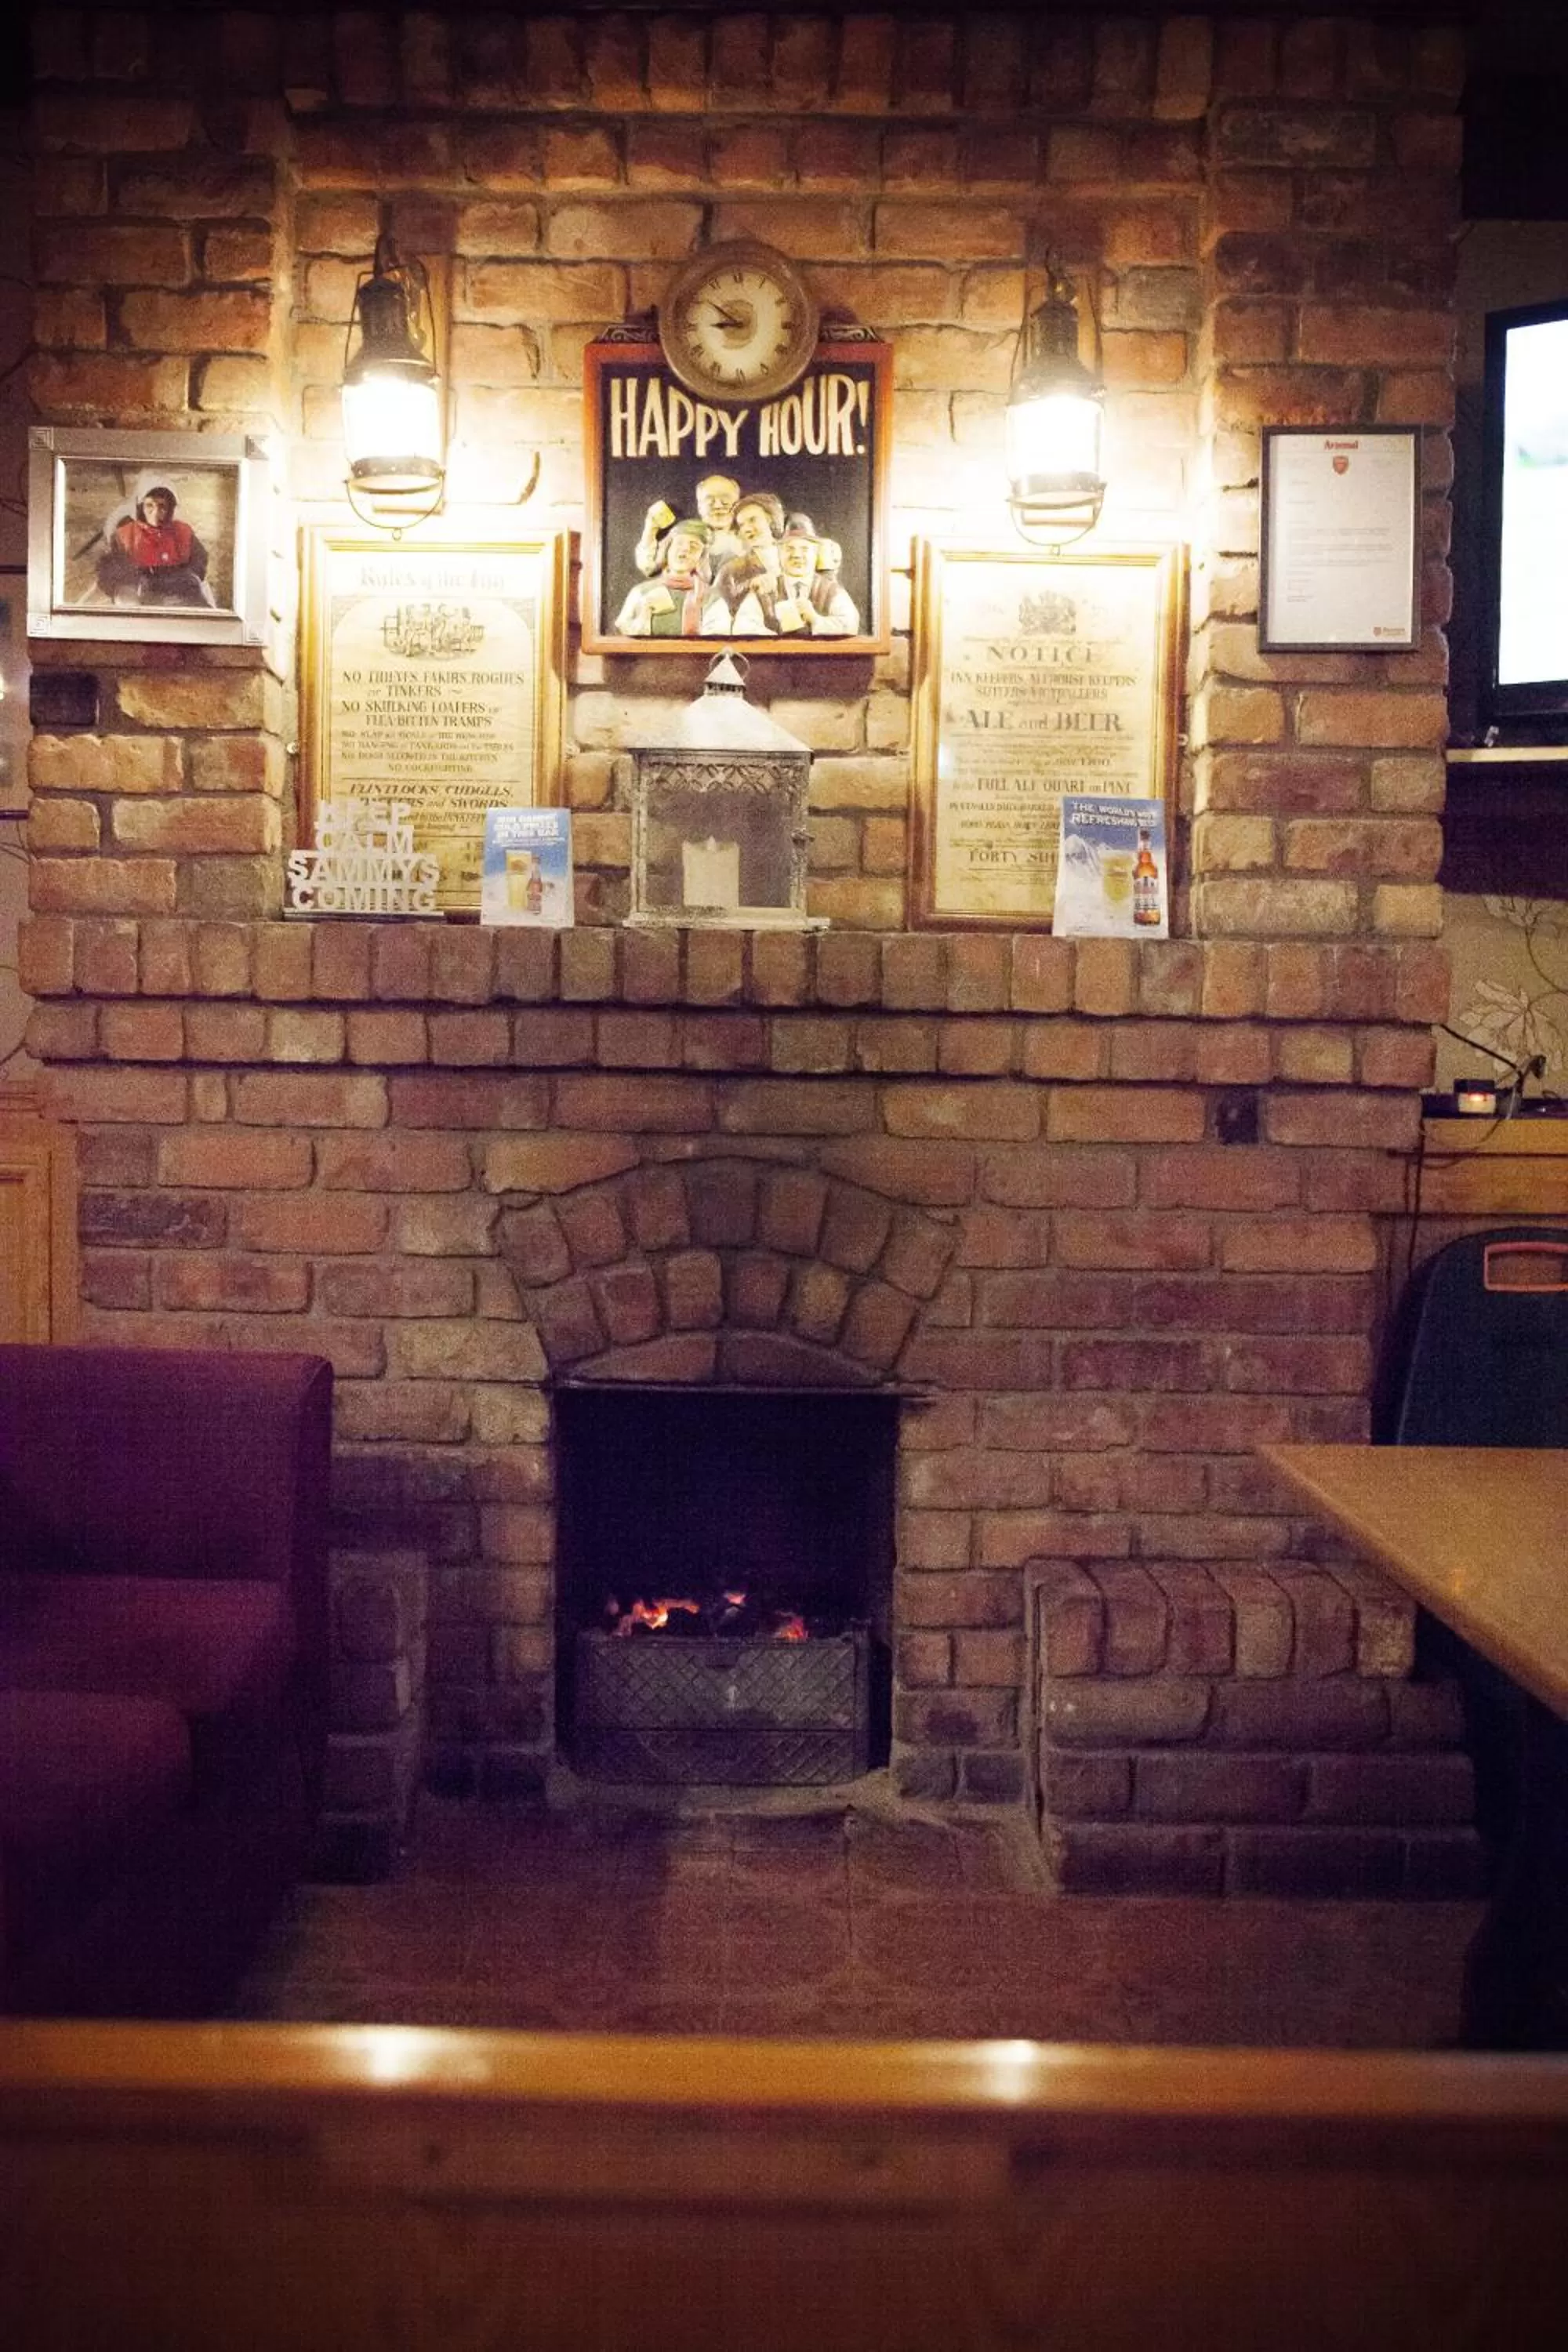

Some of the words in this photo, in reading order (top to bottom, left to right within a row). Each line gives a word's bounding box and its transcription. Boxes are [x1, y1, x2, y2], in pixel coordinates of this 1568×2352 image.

[609, 376, 748, 458] HAPPY
[758, 373, 871, 456] HOUR!
[986, 644, 1101, 664] NOTICE
[343, 670, 362, 684] NO
[470, 670, 524, 685] ROGUES
[386, 684, 441, 698] TINKERS
[341, 700, 361, 713] NO
[365, 699, 427, 713] SKULKING
[430, 700, 486, 714] LOAFERS
[441, 714, 493, 728] TRAMPS
[964, 708, 1014, 729] ALE
[1018, 712, 1049, 730] and
[1054, 710, 1124, 732] BEER
[978, 777, 1009, 791] FULL
[1043, 779, 1084, 793] QUART
[426, 798, 445, 808] and
[1072, 800, 1095, 812] THE
[318, 799, 412, 829] KEEP
[314, 824, 414, 853] CALM
[967, 849, 1016, 863] FORTY
[292, 884, 437, 912] COMING
